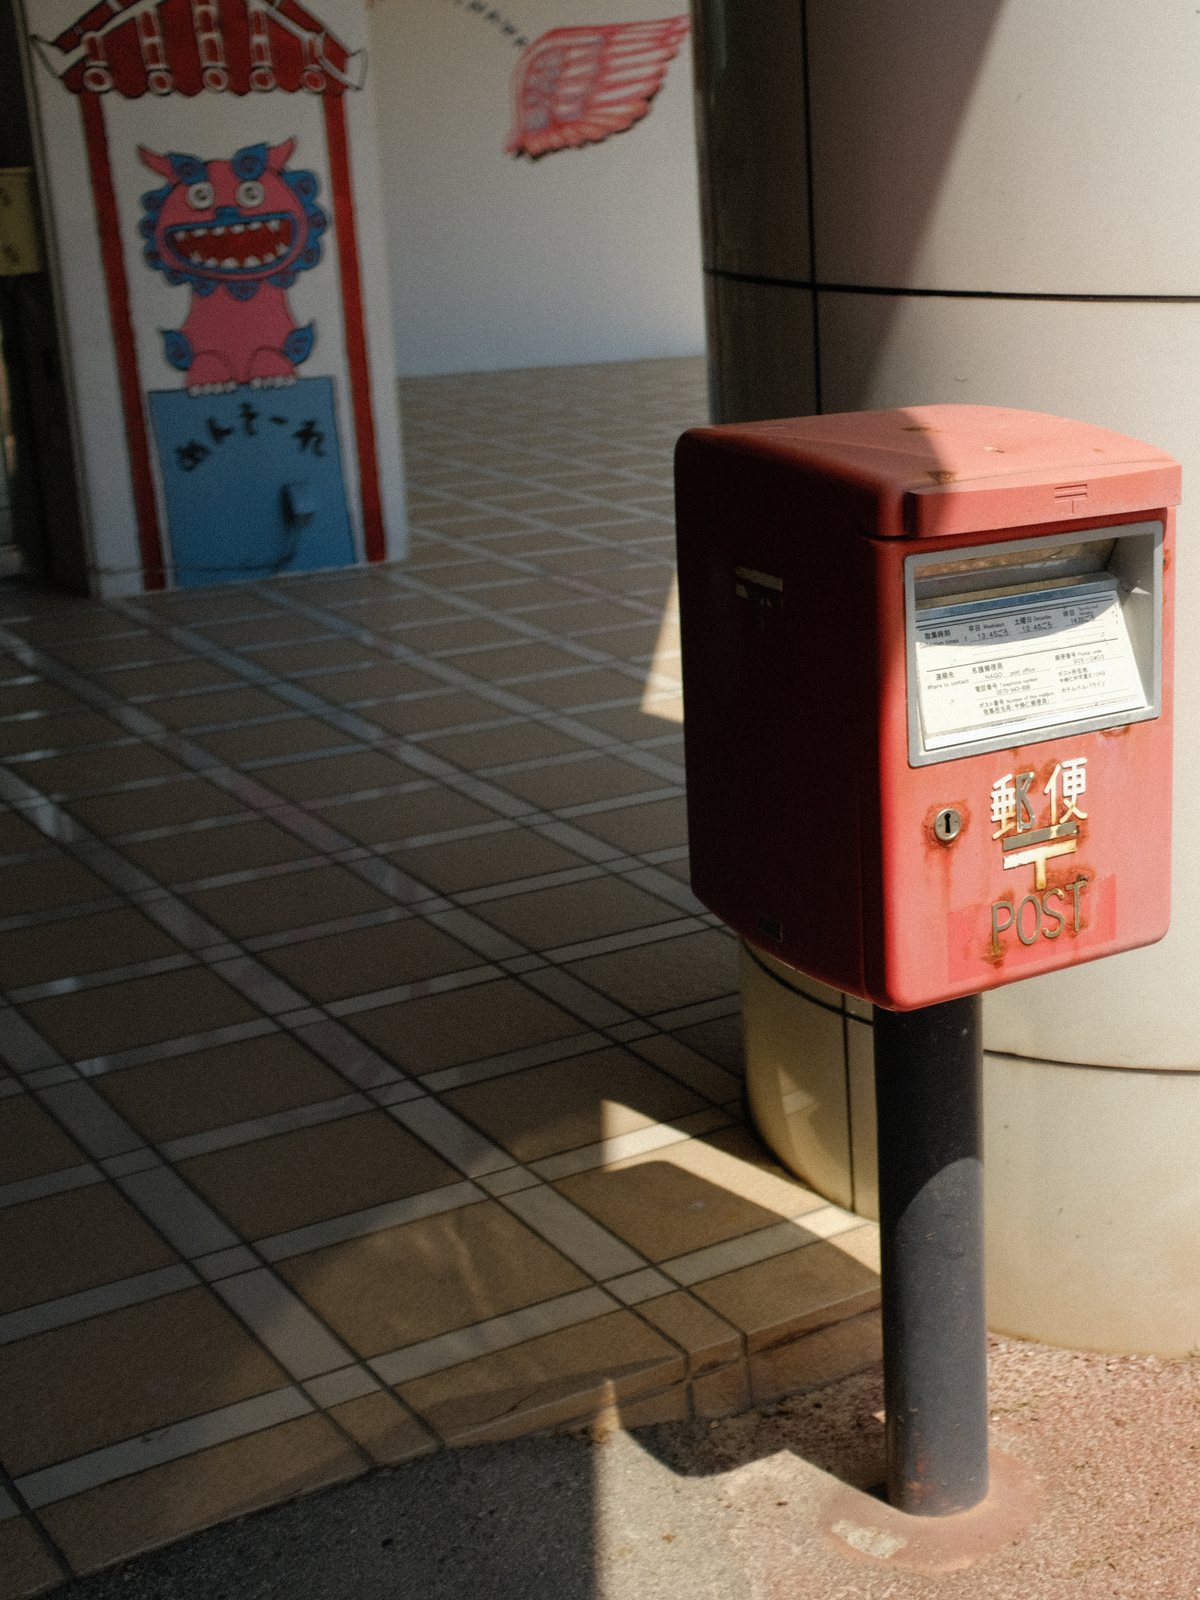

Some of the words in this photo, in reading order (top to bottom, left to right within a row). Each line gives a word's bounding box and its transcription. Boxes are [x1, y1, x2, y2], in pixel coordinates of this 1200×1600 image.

[175, 402, 326, 472] めんそーれ
[968, 624, 981, 633] 平日
[1014, 616, 1033, 626] 土曜日
[984, 671, 1003, 680] NAGO
[990, 756, 1088, 840] 郵便
[991, 880, 1087, 956] POST
